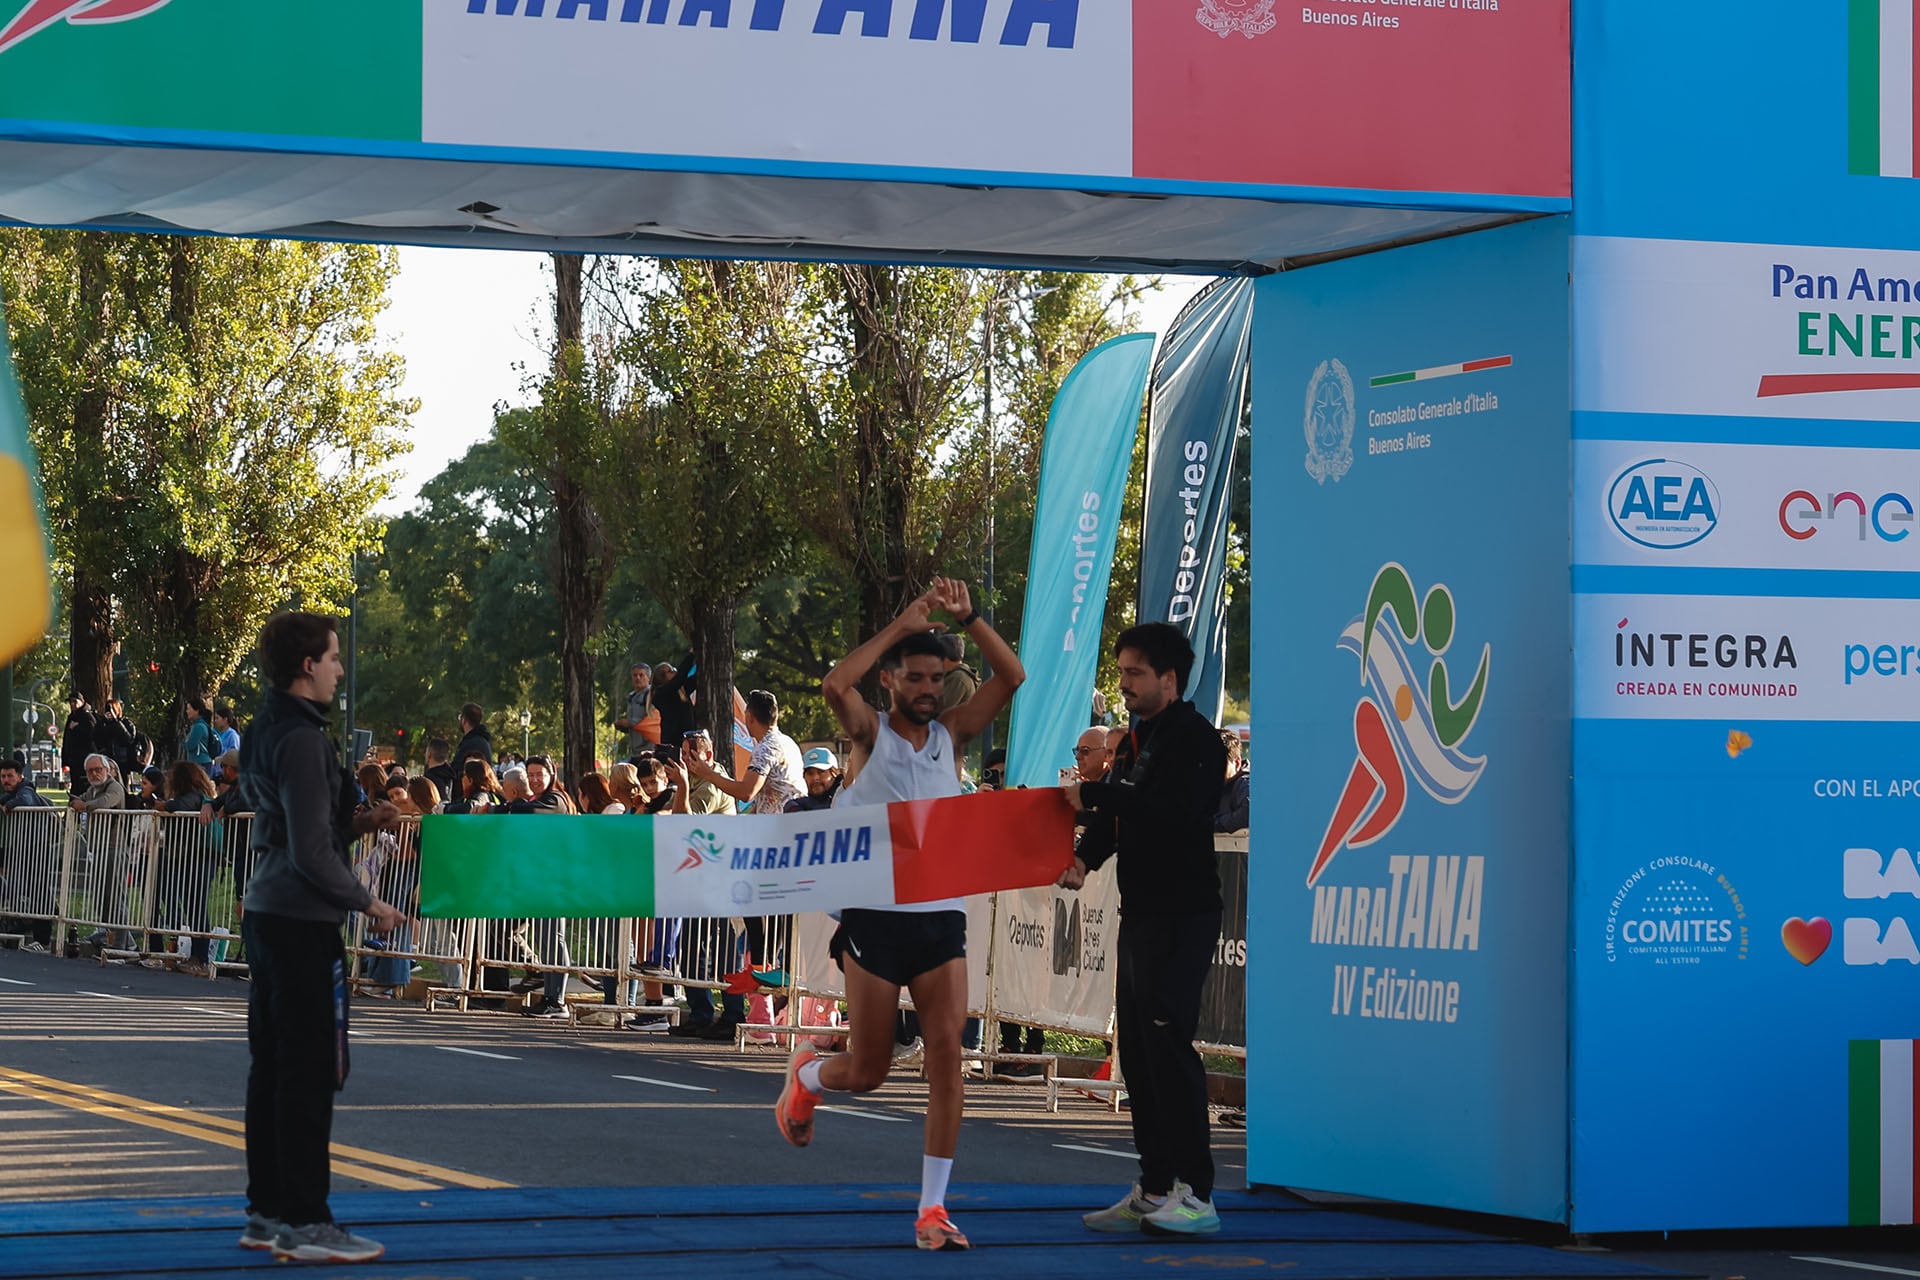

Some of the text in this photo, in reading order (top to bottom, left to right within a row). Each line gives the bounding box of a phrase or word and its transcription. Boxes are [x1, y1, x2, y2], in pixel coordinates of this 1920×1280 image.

[1301, 8, 1400, 29] Buenos Aires
[1449, 0, 1499, 11] dItalia
[1772, 264, 1838, 300] Pan
[1798, 311, 1920, 359] ENER
[1368, 391, 1499, 427] Consolato Generale d'Italia
[1368, 431, 1432, 455] Buenos Aires
[1619, 475, 1717, 522] AEA
[1168, 440, 1209, 623] Deportes
[1616, 617, 1798, 669] ÍNTEGRA
[1616, 682, 1798, 697] CREADA EN COMUNIDAD
[1814, 779, 1856, 797] CON
[1863, 779, 1883, 797] EL
[730, 826, 872, 870] MARATANA
[1310, 855, 1485, 951] MARATANA
[1606, 867, 1647, 962] CIRCOSCRIZIONE
[1650, 855, 1716, 876] CONSOLARE
[1009, 914, 1045, 953] Deportes
[1623, 919, 1733, 943] COMITES
[1655, 957, 1669, 965] ALL
[1331, 964, 1460, 1023] IV Edizione
